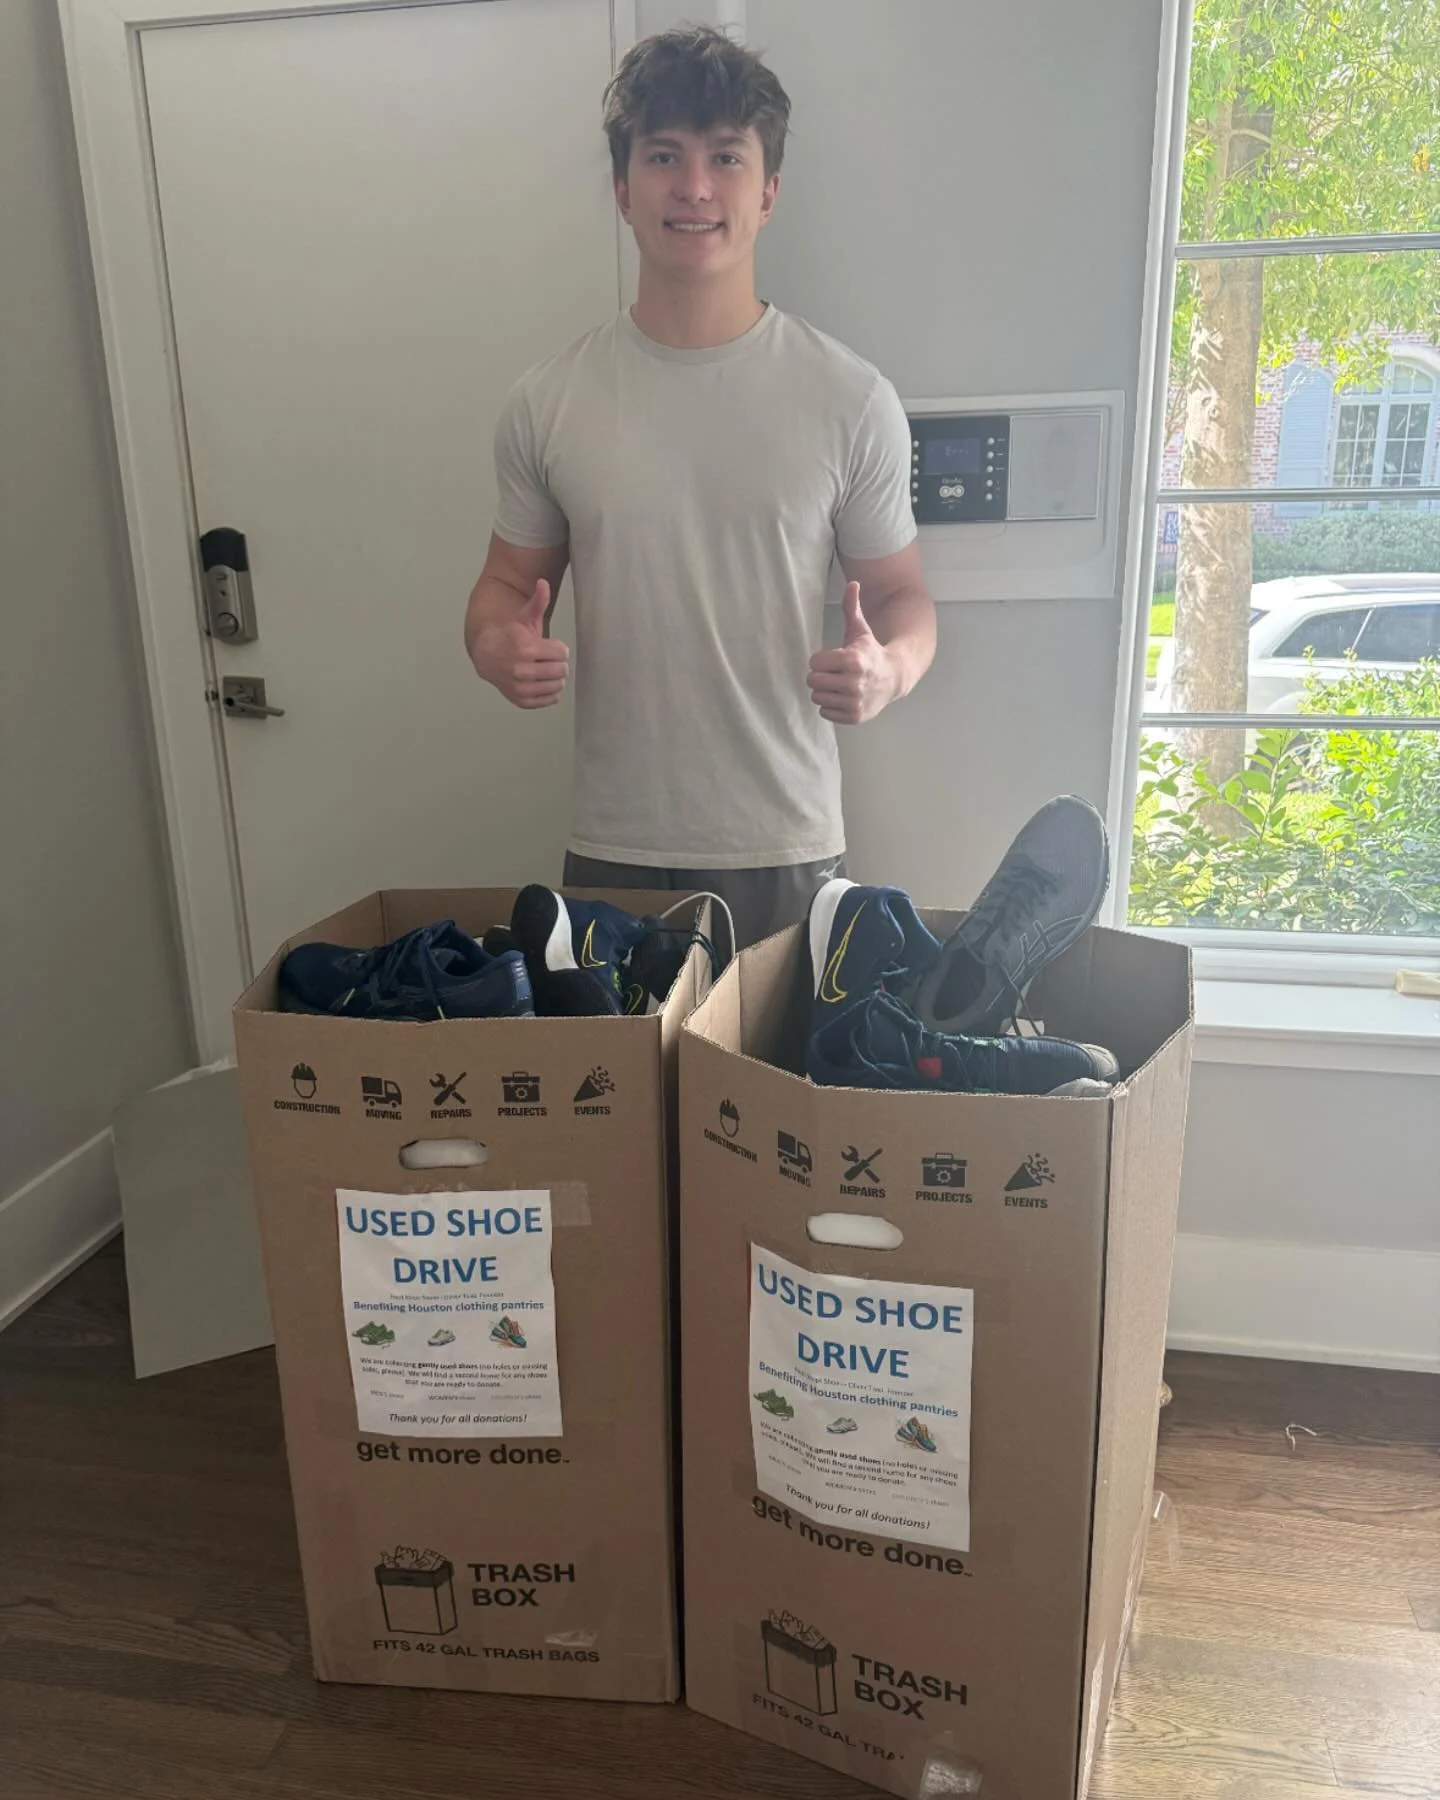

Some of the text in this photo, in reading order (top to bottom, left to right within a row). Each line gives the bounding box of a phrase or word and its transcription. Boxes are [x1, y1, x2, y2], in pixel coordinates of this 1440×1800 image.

[274, 1101, 611, 1120] CONSTRUCTION MOVING REPAIRS PROJECTS EVENTS
[704, 1128, 1048, 1209] CONSTRUCTION MOVING REPAIRS PROJECTS EVENTS
[346, 1206, 543, 1237] USED SHOE
[393, 1256, 499, 1285] DRIVE
[353, 1301, 545, 1313] Benefiting Houston clothing pantries
[758, 1263, 963, 1334] USED SHOE
[798, 1332, 909, 1378] DRIVE
[759, 1361, 808, 1392] Benefiting
[810, 1385, 858, 1402] Houston
[860, 1394, 907, 1410] clothing
[910, 1401, 958, 1417] pantries
[389, 1413, 528, 1425] Thank you for all donations!
[356, 1441, 400, 1462] get
[408, 1447, 481, 1465] more
[786, 1484, 814, 1505] Thank
[815, 1500, 834, 1512] you
[836, 1504, 852, 1516] for
[855, 1508, 869, 1519] all
[871, 1511, 931, 1530] donations!
[751, 1495, 793, 1530] get
[800, 1520, 874, 1557] more
[467, 1563, 576, 1583] TRASH
[472, 1588, 540, 1607] BOX
[373, 1639, 600, 1663] FITS 42 GAL TRASH BAGS
[851, 1653, 968, 1706] TRASH
[854, 1679, 925, 1721] BOX
[752, 1693, 789, 1719] FITS
[794, 1713, 815, 1728] 42
[819, 1725, 857, 1748] GAL
